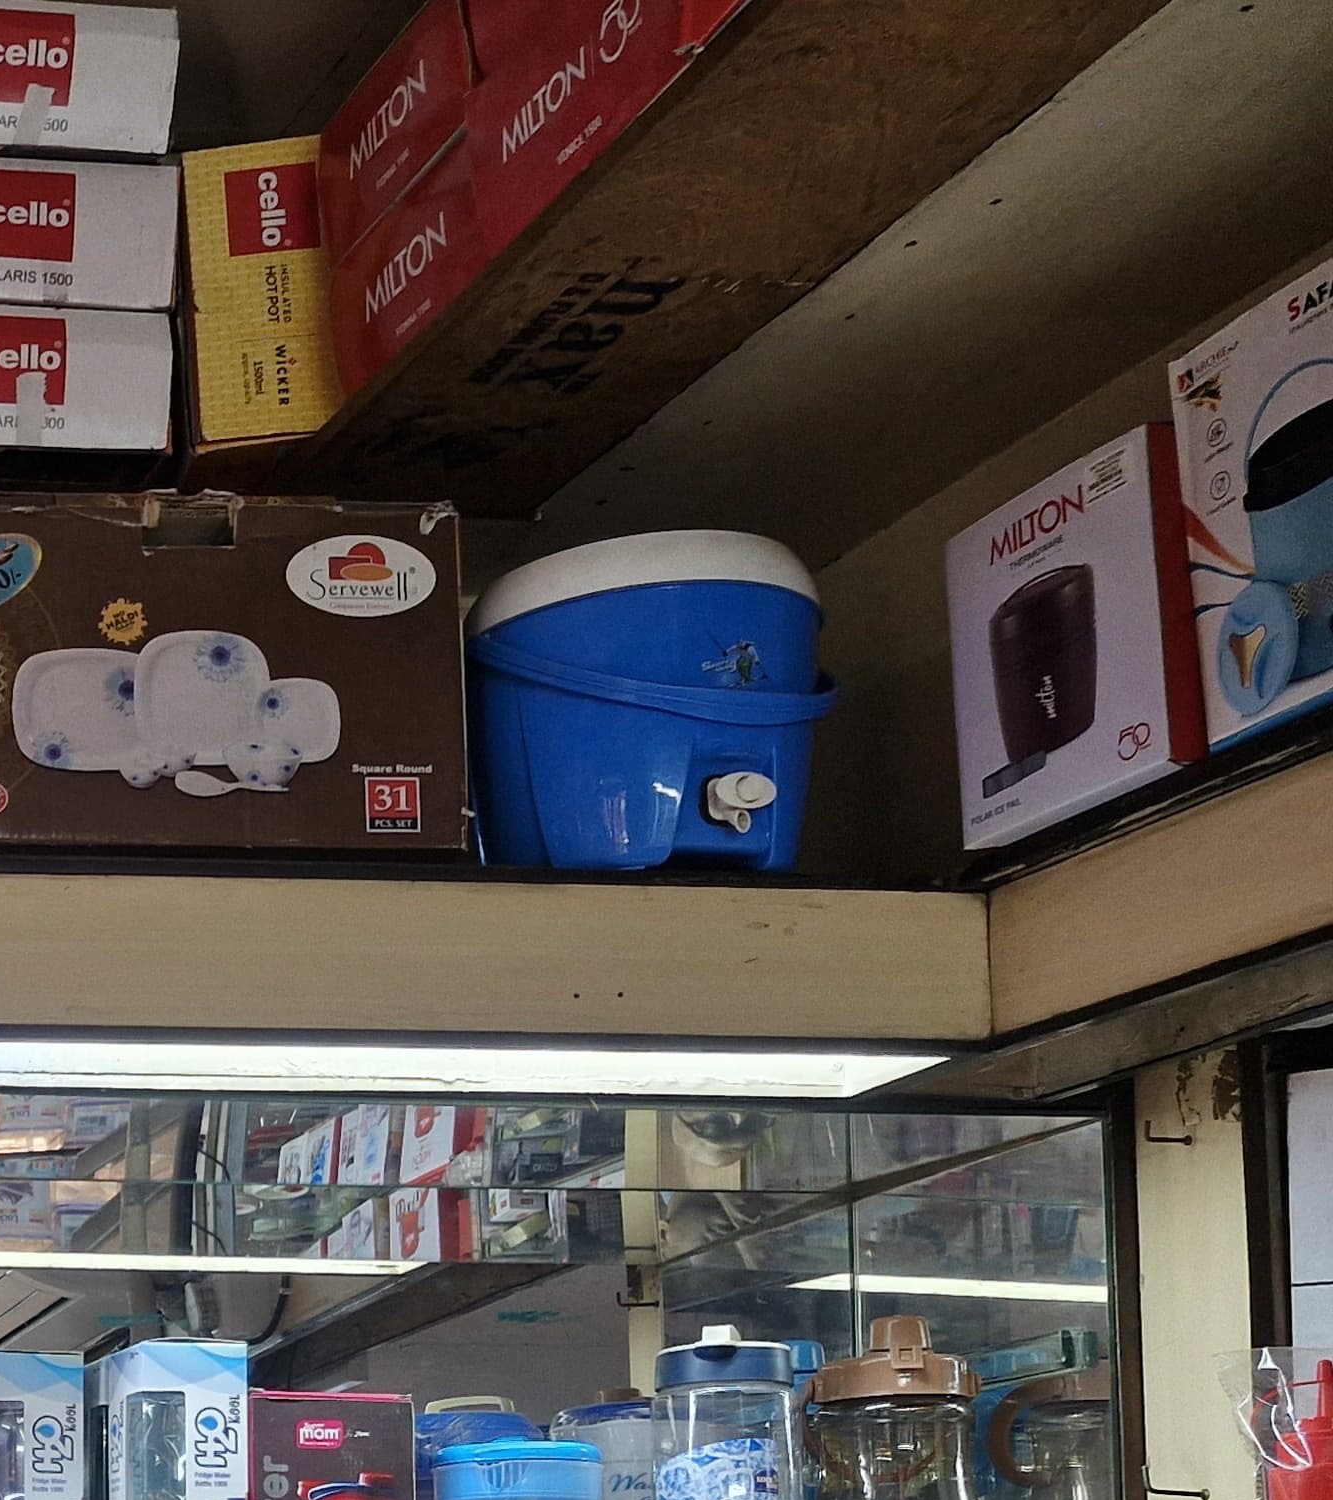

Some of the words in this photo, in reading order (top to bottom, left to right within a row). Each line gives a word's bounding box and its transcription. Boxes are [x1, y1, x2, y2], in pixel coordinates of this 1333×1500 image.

[501, 46, 585, 165] MILTON
[257, 170, 288, 248] cello
[41, 271, 73, 287] 1500
[281, 263, 291, 324] INSULATED
[365, 211, 447, 324] MILTON
[275, 344, 289, 407] WICKER
[989, 484, 1086, 566] MILTON
[308, 568, 409, 602] Servewell
[351, 763, 391, 776] Square
[395, 763, 433, 775] Round
[372, 784, 412, 812] 31
[394, 819, 413, 829] SET
